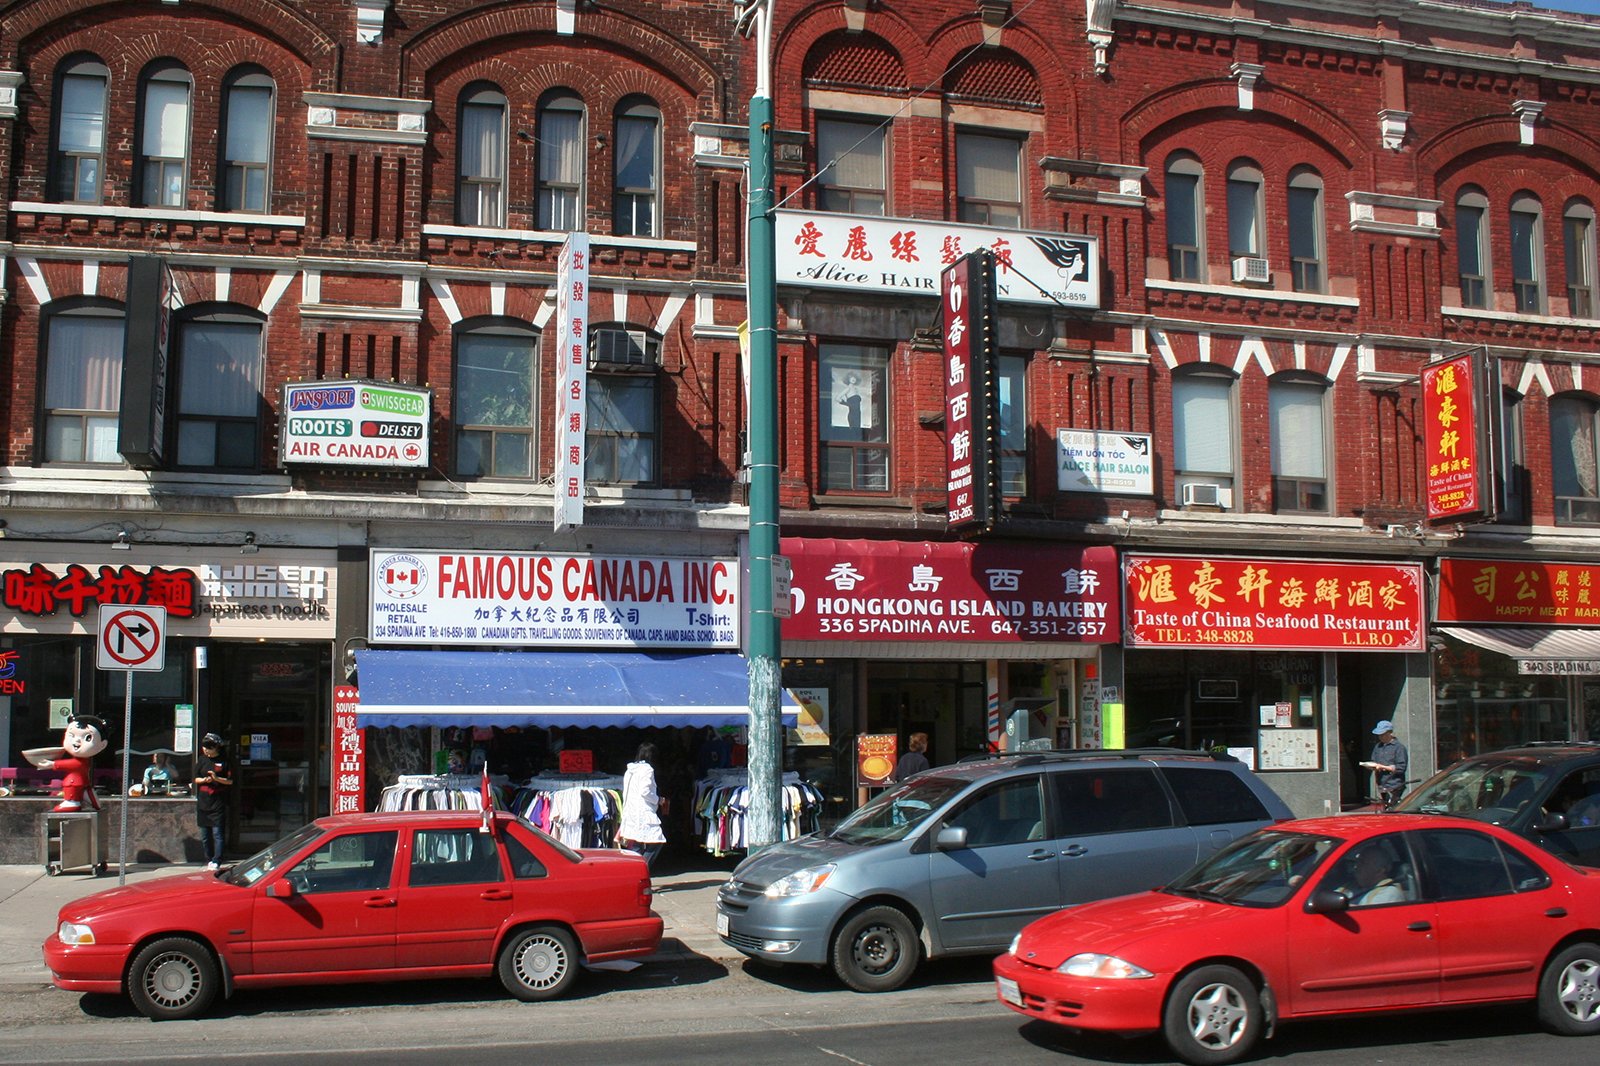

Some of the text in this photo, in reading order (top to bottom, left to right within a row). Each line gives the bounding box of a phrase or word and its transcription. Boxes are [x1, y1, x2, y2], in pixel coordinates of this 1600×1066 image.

[794, 221, 1014, 275] 愛麗絲髮廊
[796, 262, 870, 284] Alice
[881, 273, 935, 290] HAIR
[1052, 291, 1087, 301] 593-8519
[947, 315, 971, 462] 香島西餅
[291, 389, 354, 410] JANSPORT
[371, 393, 424, 414] SWISSGEAR
[291, 419, 345, 435] ROOTS
[379, 424, 421, 437] DELSEY
[290, 442, 399, 459] AIR CANADA
[1062, 461, 1150, 475] ALICE HAIR SALON
[1453, 473, 1472, 482] China
[956, 493, 968, 506] 647
[949, 505, 974, 523] 351-265
[438, 555, 553, 601] FAMOUS
[563, 557, 675, 603] CANADA
[683, 561, 734, 605] INC.
[825, 562, 1100, 596] 香島西餅
[197, 600, 327, 617] japanese noodle
[376, 603, 428, 613] WHOLESALE
[473, 605, 640, 625] 加拿大紀念品有限公司
[817, 597, 1108, 619] HONGKONG ISLAND BAKERY
[1495, 606, 1600, 617] HAPPY MEAT MAR
[388, 614, 417, 624] RETAIL
[819, 618, 1107, 636] 336 SPADINA AVE. 647-351-2657
[1134, 610, 1411, 630] Taste of China Seafood Restaurant
[375, 626, 386, 637] 334
[387, 626, 413, 638] SPADINA
[414, 626, 426, 638] AVE
[481, 627, 510, 639] CANADIAN
[529, 627, 561, 640] TRAVELLING
[584, 628, 615, 640] SOUVENIRS
[615, 629, 623, 640] OF
[664, 630, 680, 641] HAND
[697, 630, 719, 642] SCHOOL
[720, 630, 734, 642] BAGS
[1156, 629, 1254, 643] TEL: 348-8828
[1523, 662, 1592, 673] 340 SPADINA
[336, 702, 357, 713] SOUVE
